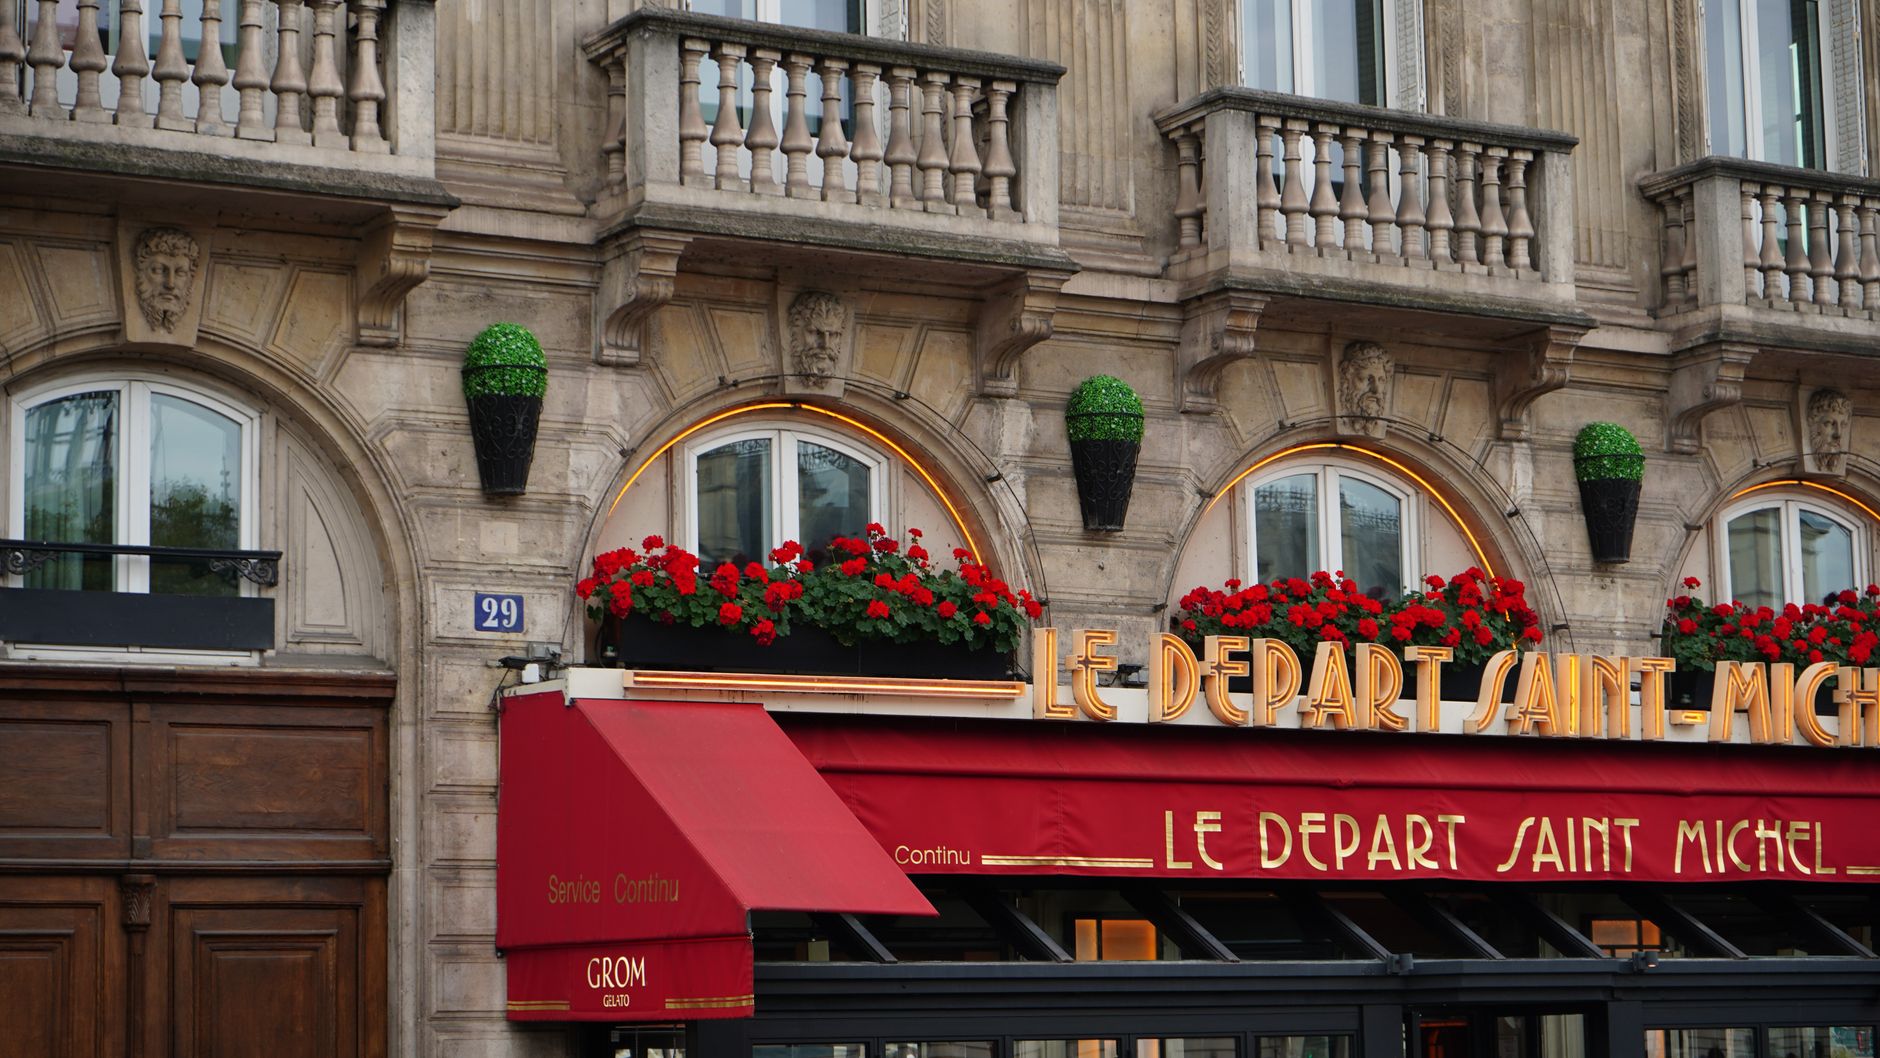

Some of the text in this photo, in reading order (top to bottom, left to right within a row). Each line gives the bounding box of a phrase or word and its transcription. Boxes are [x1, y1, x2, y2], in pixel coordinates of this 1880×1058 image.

[481, 598, 518, 627] 29
[1032, 627, 1118, 721] LE
[1148, 632, 1454, 734] DEPART
[894, 845, 971, 867] Continu
[1166, 811, 1837, 876] LE DEPART SAINT MICHEL
[548, 872, 679, 904] Service Continu
[587, 956, 647, 989] GROM
[603, 994, 630, 1008] GELATO
